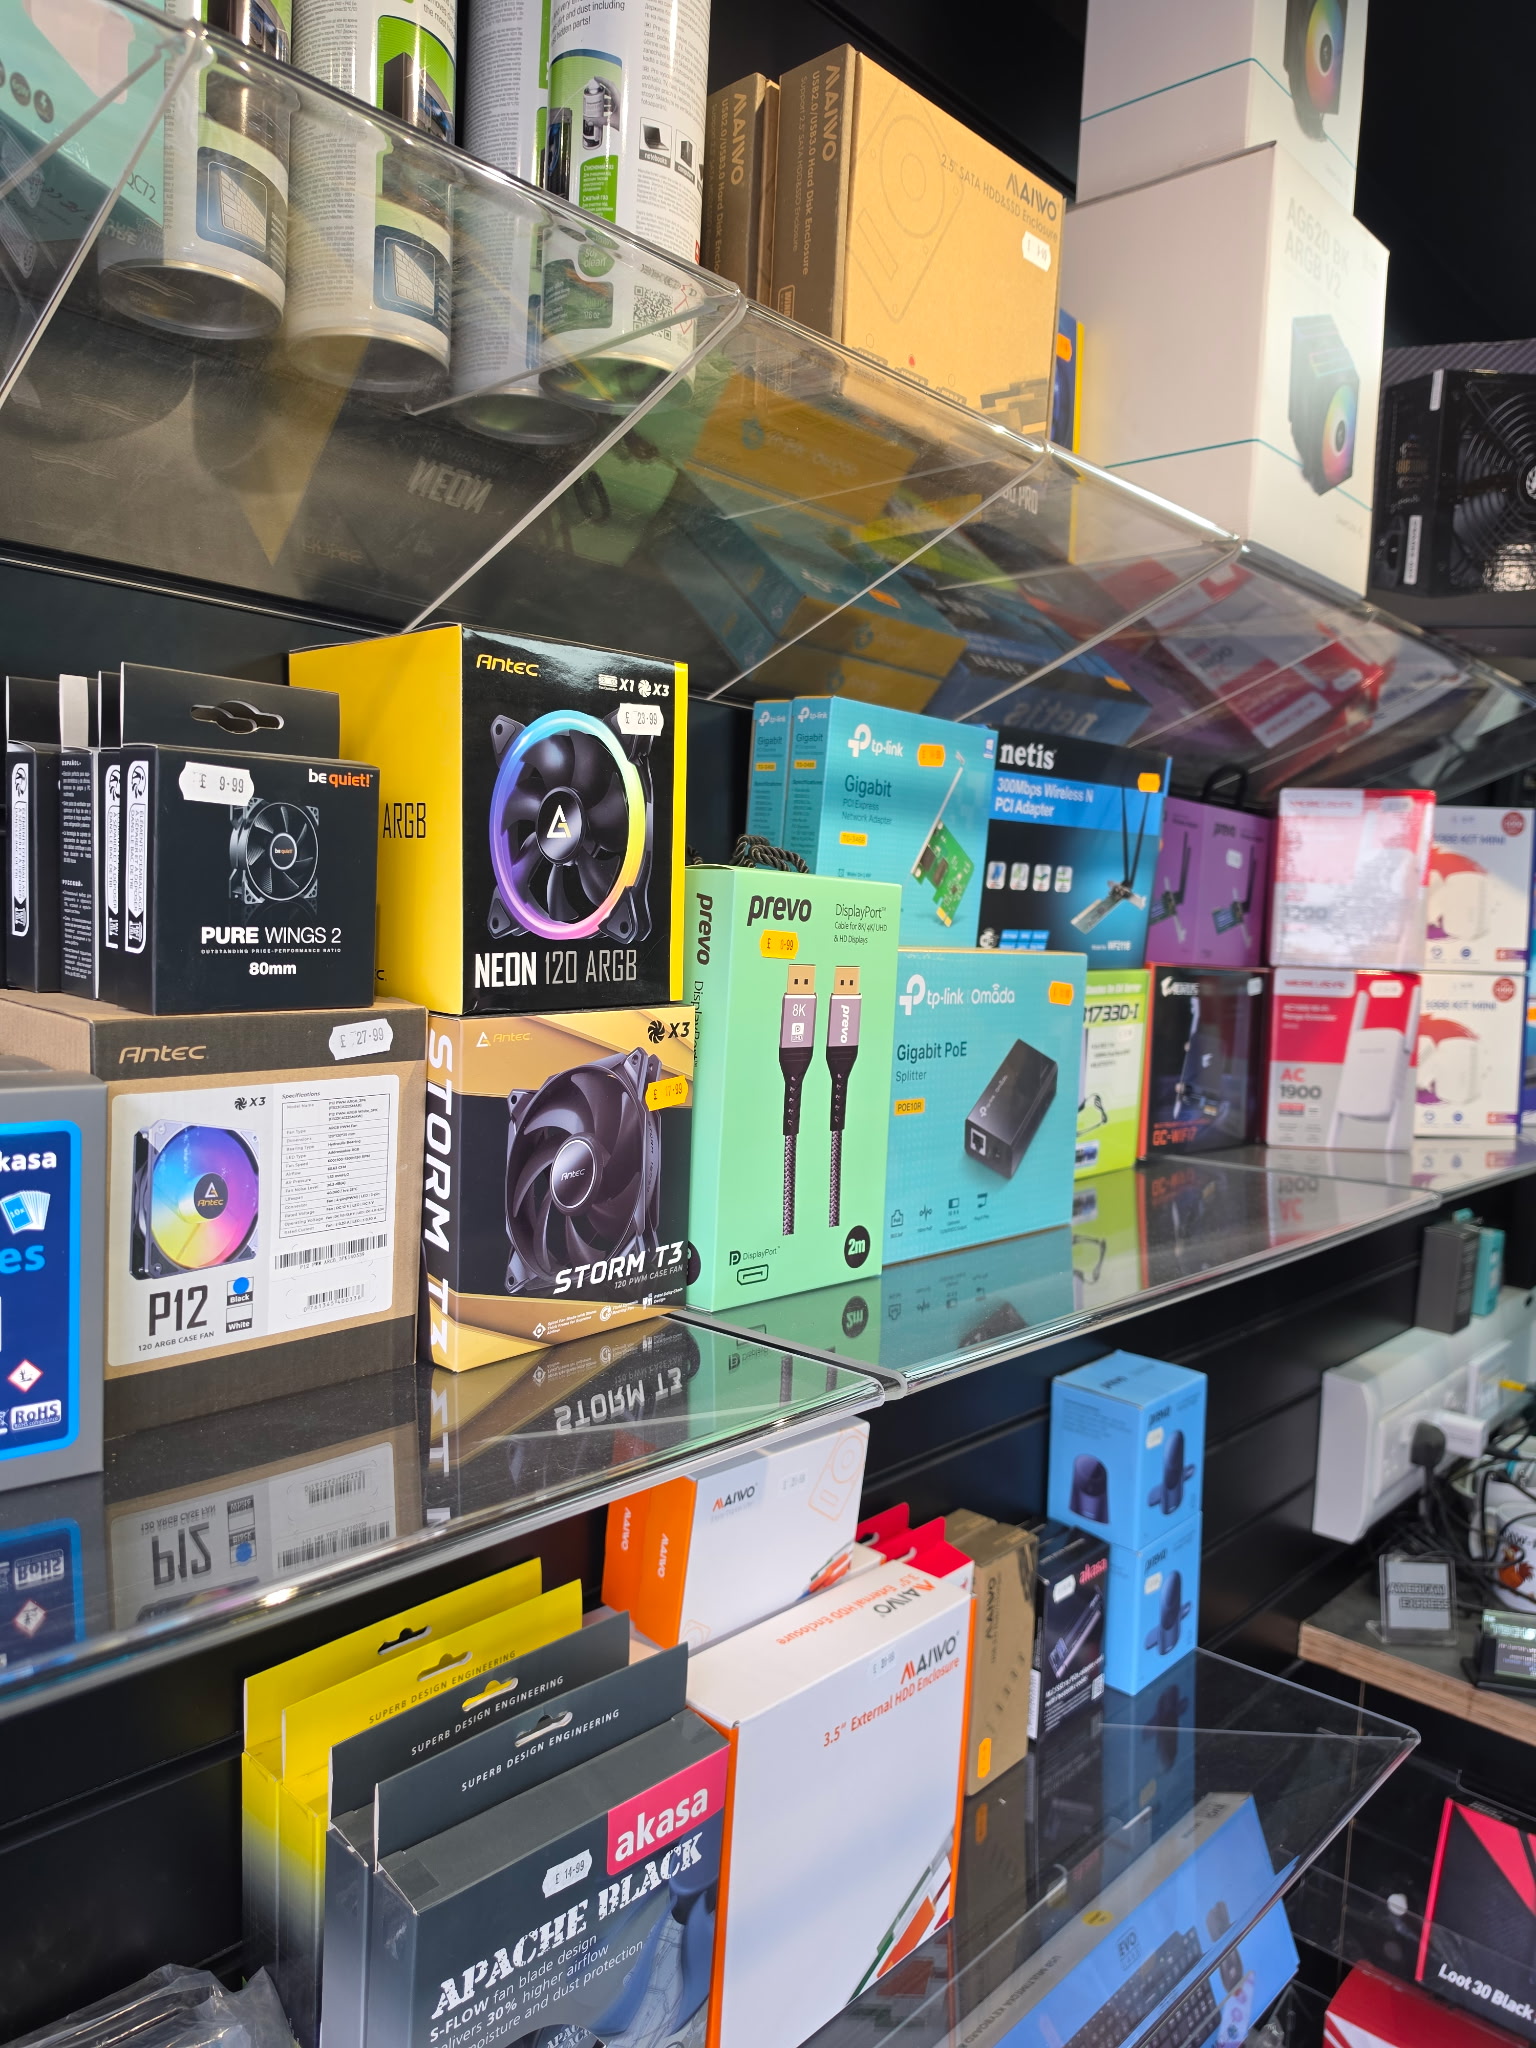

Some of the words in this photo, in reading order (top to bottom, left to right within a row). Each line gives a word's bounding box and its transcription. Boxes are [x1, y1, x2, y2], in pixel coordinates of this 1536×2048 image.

[566, 8, 577, 19] and
[577, 3, 592, 14] dust
[592, 1, 625, 13] including
[573, 17, 592, 31] parts!
[799, 76, 807, 113] Support
[807, 70, 820, 157] USB2.0/USB3.0
[822, 65, 841, 162] MAIWO
[717, 98, 728, 182] USB2.0/USB3.0
[730, 93, 747, 185] MAIWO
[796, 133, 805, 159] SATA
[806, 157, 816, 187] Hard
[717, 182, 725, 210] Hard
[804, 189, 815, 216] Disk
[960, 166, 981, 192] SATA
[983, 181, 1021, 217] HDD&SSD
[1022, 209, 1058, 244] Enclosure
[1006, 172, 1057, 222] MAIWO
[715, 212, 724, 238] Disk
[792, 207, 801, 252] Enclosure
[802, 216, 813, 276] Enclosure
[476, 653, 541, 678] Antec
[619, 679, 635, 693] X1
[653, 684, 670, 698] X3
[809, 711, 828, 721] tp-link
[756, 735, 782, 747] Gigabit
[795, 732, 824, 745] Gigabit
[871, 740, 903, 758] tp-link
[999, 743, 1055, 770] netis
[219, 775, 245, 794] 9-99
[308, 768, 327, 784] be
[329, 769, 370, 788] quiet!
[844, 774, 892, 797] Gigabit
[996, 777, 1042, 799] 300Mbps
[1044, 783, 1083, 802] Wireless
[1085, 788, 1094, 803] N
[842, 799, 857, 809] PCI
[859, 800, 879, 811] Express
[995, 797, 1016, 812] PCI
[1017, 801, 1055, 818] Adapter
[382, 802, 426, 839] ARGB
[842, 811, 865, 823] Network
[867, 813, 893, 826] Adapter
[746, 894, 812, 926] prevo
[201, 926, 259, 945] PURE
[265, 926, 326, 944] WINGS
[331, 926, 342, 944] 2
[696, 892, 714, 965] prevo
[834, 921, 849, 930] Cable
[849, 922, 857, 930] for
[875, 924, 888, 932] UHD
[839, 934, 848, 943] HD
[848, 935, 868, 945] Displays
[249, 961, 297, 975] 80mm
[474, 951, 537, 988] NEON
[545, 951, 580, 986] 120
[585, 949, 637, 983] ARGB
[792, 1003, 806, 1018] 8K
[927, 987, 963, 1009] tp-link
[357, 1027, 385, 1045] 27-99
[668, 1021, 690, 1039] X3
[840, 1003, 849, 1044] prevo
[493, 1032, 531, 1042] Antec
[118, 1044, 207, 1065] Antec
[897, 1042, 942, 1064] Gigabit
[944, 1041, 967, 1058] PoE
[895, 1069, 927, 1084] Splitter
[1281, 1067, 1305, 1083] AC
[248, 1096, 267, 1107] X3
[282, 1091, 321, 1100] Specifications
[1279, 1084, 1322, 1100] 1900
[897, 1101, 922, 1113] POE10R
[424, 1028, 452, 1253] STORM
[560, 1166, 586, 1182] Antec
[9, 1208, 26, 1219] 10x
[197, 1197, 224, 1207] Antec
[742, 1246, 781, 1261] DisplayPort
[847, 1236, 866, 1256] 2m
[553, 1251, 645, 1295] STORM
[655, 1240, 684, 1266] T3
[614, 1280, 627, 1289] 120
[628, 1275, 647, 1287] PWM
[649, 1270, 668, 1282] CASE
[669, 1265, 684, 1277] FAN
[149, 1284, 208, 1337] P12
[229, 1294, 250, 1303] Black
[228, 1320, 250, 1330] White
[428, 1278, 449, 1355] T3
[138, 1342, 153, 1351] 120
[154, 1338, 177, 1349] ARGB
[178, 1333, 198, 1346] CASE
[199, 1330, 215, 1341] FAN
[15, 1402, 59, 1423] RoHS
[711, 1484, 755, 1512] MAIWO
[621, 1506, 631, 1551] MAIWO
[657, 1533, 669, 1579] MAIWO
[1079, 1557, 1107, 1585] akasa
[862, 1583, 900, 1609] External
[873, 1578, 935, 1617] MAIWO
[831, 1599, 864, 1623] HDD
[776, 1608, 835, 1647] Enclosure
[900, 1635, 957, 1685] MAIWO
[368, 1700, 408, 1724] SUPERB
[410, 1681, 448, 1708] DESIGN
[451, 1649, 517, 1686] ENGINEERING
[850, 1697, 893, 1732] External
[894, 1681, 915, 1708] HDD
[916, 1655, 960, 1694] Enclosure
[411, 1728, 451, 1755] SUPERB
[454, 1707, 491, 1735] DESIGN
[495, 1675, 564, 1713] ENGINEERING
[461, 1764, 502, 1792] SUPERB
[506, 1741, 545, 1769] DESIGN
[548, 1708, 620, 1749] ENGINEERING
[614, 1784, 709, 1862] akasa
[564, 1857, 586, 1882] 14-99
[431, 1899, 589, 2019] APACHE
[597, 1831, 703, 1924] BLACK
[430, 1997, 490, 2043] S-FLOW
[493, 1983, 514, 2005] fan
[518, 1966, 554, 1996] blade
[557, 1932, 598, 1975] design
[486, 2001, 517, 2027] 30%
[522, 1979, 564, 2021] higher
[567, 1941, 609, 1977] airflow
[524, 1993, 549, 2019] and
[552, 1978, 580, 2003] dust
[583, 1938, 644, 1986] protection
[1437, 1963, 1472, 1991] Loot
[1471, 1980, 1493, 1999] 30
[1490, 1989, 1534, 2021] Black
